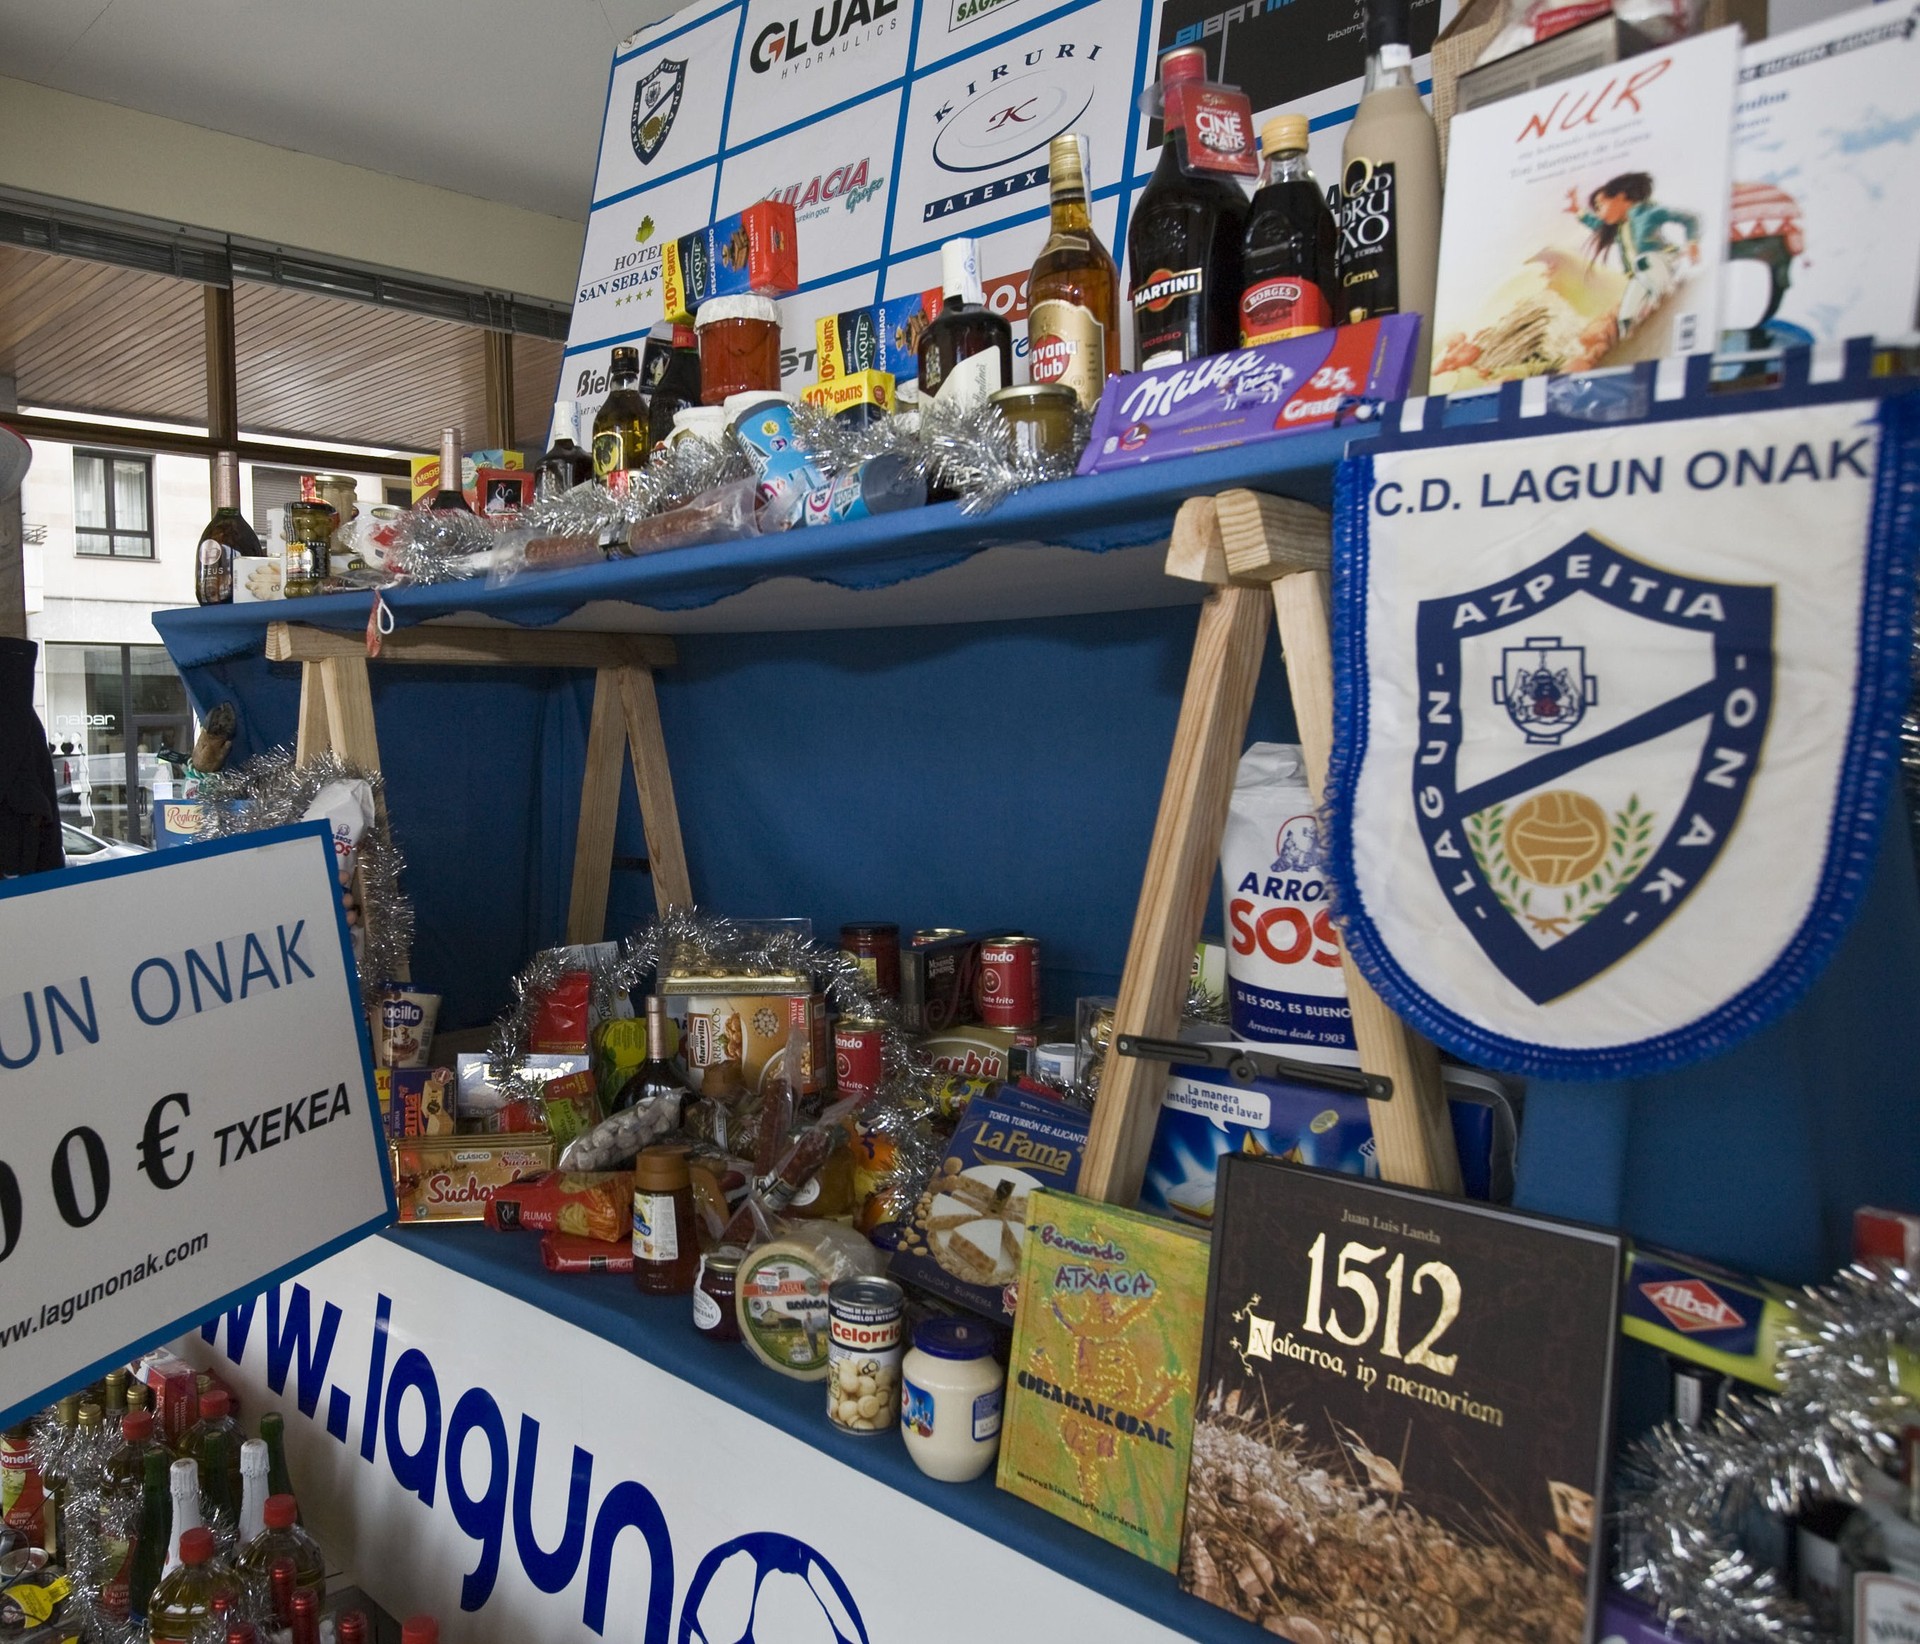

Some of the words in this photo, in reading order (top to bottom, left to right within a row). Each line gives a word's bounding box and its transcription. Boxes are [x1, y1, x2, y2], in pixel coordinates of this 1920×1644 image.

[781, 18, 897, 80] HYDRAULICS
[933, 43, 1103, 124] KIRURI
[1516, 58, 1672, 143] NUR
[1195, 112, 1243, 136] CINE
[1198, 130, 1247, 149] GRATIS
[925, 170, 1051, 218] JATETX
[666, 244, 676, 277] GRATIS
[693, 242, 704, 291] BAQUE
[708, 228, 717, 295] DESCAFEINADO
[578, 281, 609, 303] SAN
[1135, 274, 1196, 308] MARTINI
[1250, 285, 1293, 305] BORGES
[823, 318, 834, 353] GRATIS
[859, 321, 869, 371] BAQUE
[878, 308, 886, 372] ESCAFEINADO
[1033, 359, 1064, 382] Club
[1120, 351, 1268, 423] Milka
[834, 384, 863, 404] GRATIS
[416, 466, 440, 484] Magg
[1374, 477, 1462, 518] C.D.
[1480, 456, 1664, 509] LAGUN
[1686, 436, 1872, 491] ONAK
[1453, 554, 1726, 630] AZPEITIA
[56, 711, 116, 726] nabar
[1229, 898, 1344, 968] SOS
[131, 919, 316, 1027] ONAK
[995, 995, 1015, 1005] frito
[1237, 990, 1246, 1001] SI
[1247, 994, 1258, 1006] ES
[1259, 998, 1286, 1013] SOS,
[1288, 1003, 1302, 1015] ES
[1304, 1005, 1352, 1019] BUENO
[698, 1018, 706, 1066] Maravilla
[1247, 1019, 1288, 1037] Arroceros
[1289, 1027, 1316, 1041] desde
[1317, 1031, 1346, 1044] 1903
[846, 1080, 863, 1090] frito
[1187, 1084, 1200, 1096] La
[1201, 1088, 1240, 1104] manera
[1166, 1089, 1220, 1112] inteligente
[1221, 1103, 1235, 1115] de
[1236, 1107, 1263, 1121] lavar
[213, 1082, 351, 1167] TXEKEA
[988, 1110, 1011, 1124] TORTA
[1011, 1116, 1042, 1131] TURRÓN
[1040, 1123, 1052, 1134] DE
[1052, 1127, 1089, 1145] ALICANTE
[457, 1152, 490, 1161] CLÁSICO
[974, 1121, 1005, 1152] La
[1003, 1129, 1072, 1172] Fama
[523, 1210, 552, 1221] PLUMAS
[1341, 1208, 1370, 1228] Juan
[1372, 1214, 1400, 1235] Luis
[1402, 1219, 1441, 1245] Landa
[953, 1285, 993, 1309] SUPREMA
[1054, 1266, 1152, 1294] ATXAGA
[1303, 1231, 1462, 1378] 1512
[1651, 1284, 1727, 1325] Albal
[1017, 1370, 1175, 1449] OBABAKOAK
[1356, 1358, 1378, 1394] in
[1386, 1371, 1504, 1428] memoriam
